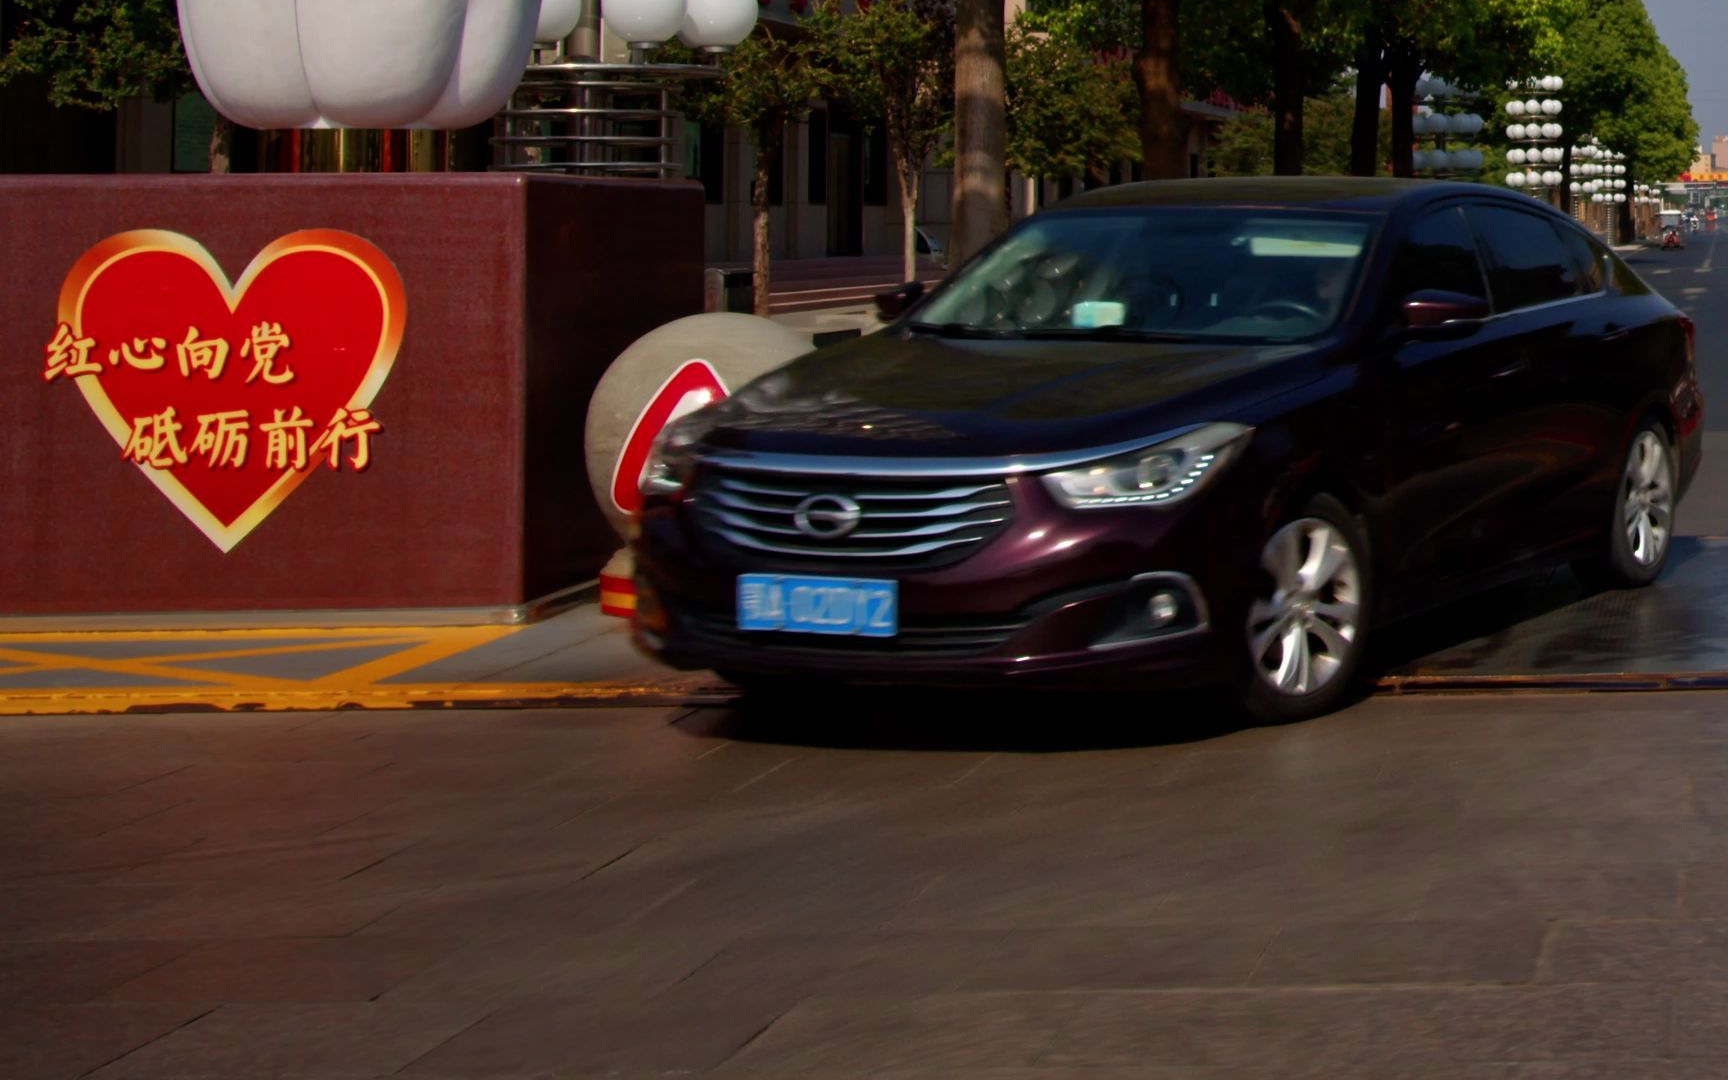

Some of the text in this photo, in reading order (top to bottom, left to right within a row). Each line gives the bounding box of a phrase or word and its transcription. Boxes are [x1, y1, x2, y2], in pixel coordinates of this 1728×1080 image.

[45, 321, 295, 384] 红心向党
[122, 406, 383, 471] 砥砺前行
